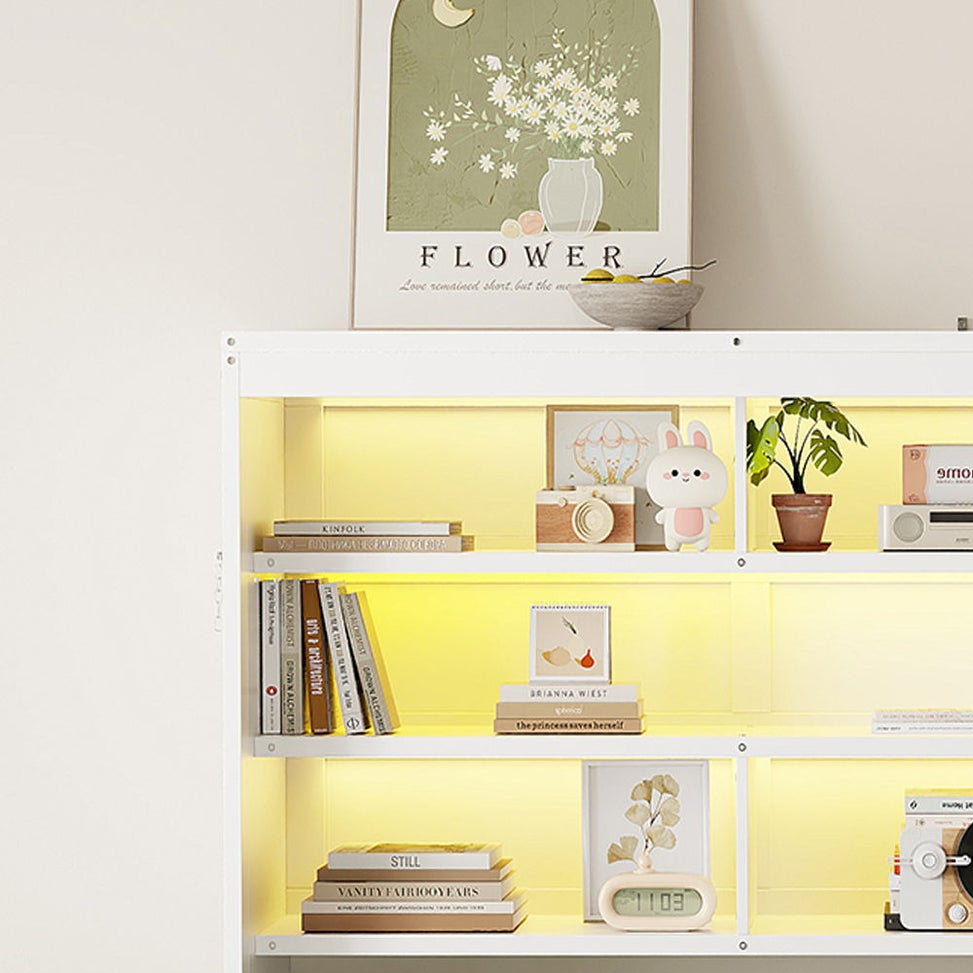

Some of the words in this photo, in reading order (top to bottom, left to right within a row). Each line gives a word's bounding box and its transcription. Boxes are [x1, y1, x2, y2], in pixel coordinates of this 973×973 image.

[420, 241, 622, 268] FLOWER
[399, 279, 427, 291] Love
[431, 279, 481, 291] remained
[535, 279, 552, 291] the
[322, 525, 366, 533] KINFOLK
[530, 689, 575, 698] BRIANNA
[578, 689, 608, 698] WIEST
[286, 692, 295, 733] ALCHEMIS
[516, 721, 531, 730] the
[531, 721, 568, 731] princess
[569, 722, 592, 730] saves
[593, 720, 624, 730] herself
[964, 802, 973, 810] at
[390, 855, 421, 868] STILL
[337, 887, 383, 897] VANITY
[386, 887, 414, 897] FAIR
[437, 887, 480, 897] YEARS
